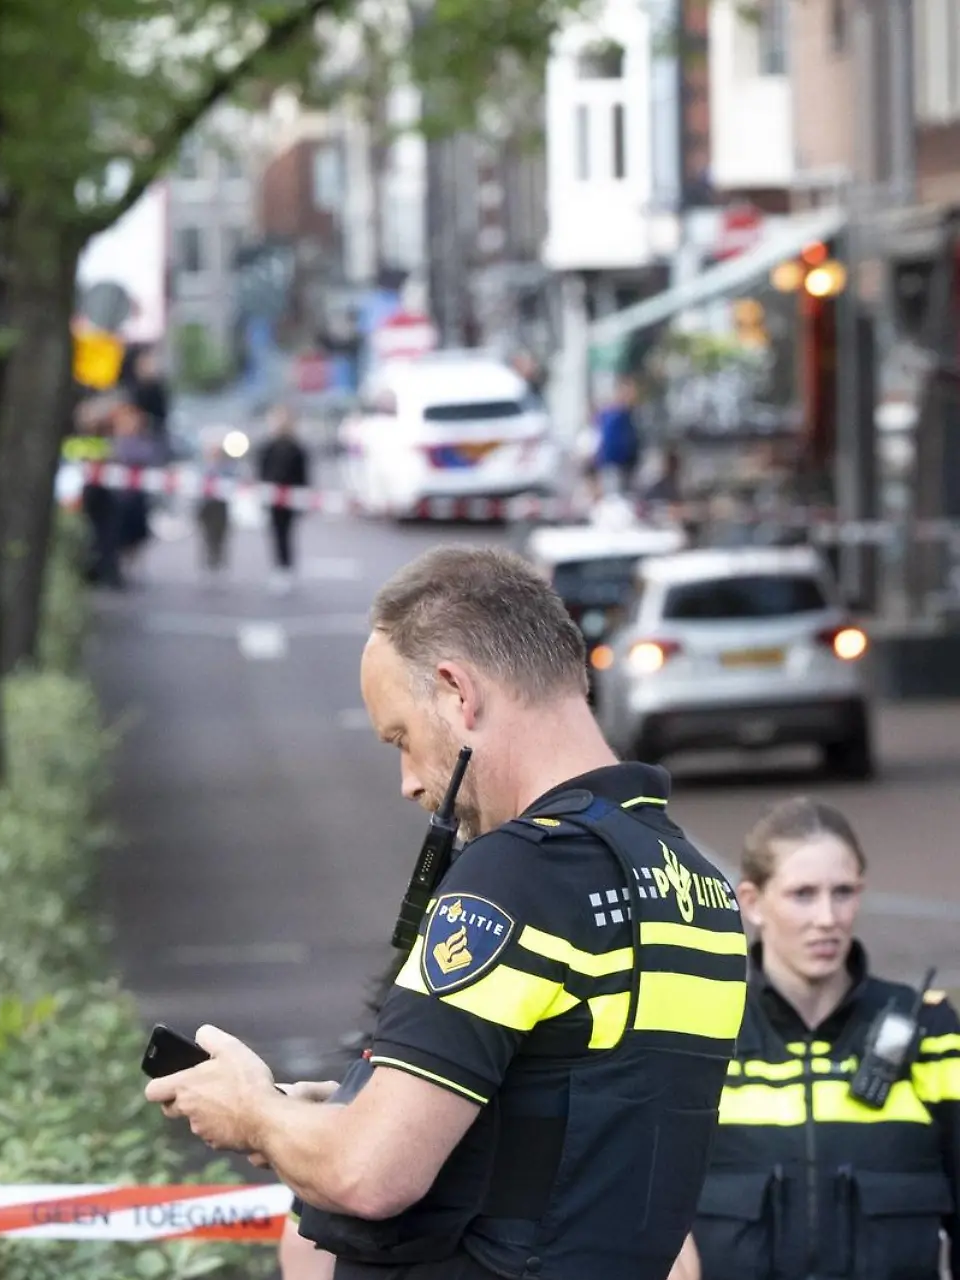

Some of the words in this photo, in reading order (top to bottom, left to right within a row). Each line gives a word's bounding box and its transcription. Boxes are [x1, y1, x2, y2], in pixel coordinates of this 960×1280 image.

[651, 860, 733, 922] POLITIE
[439, 902, 504, 936] POLITIE
[31, 1202, 111, 1227] GEEN
[132, 1203, 271, 1229] TOEGANG
